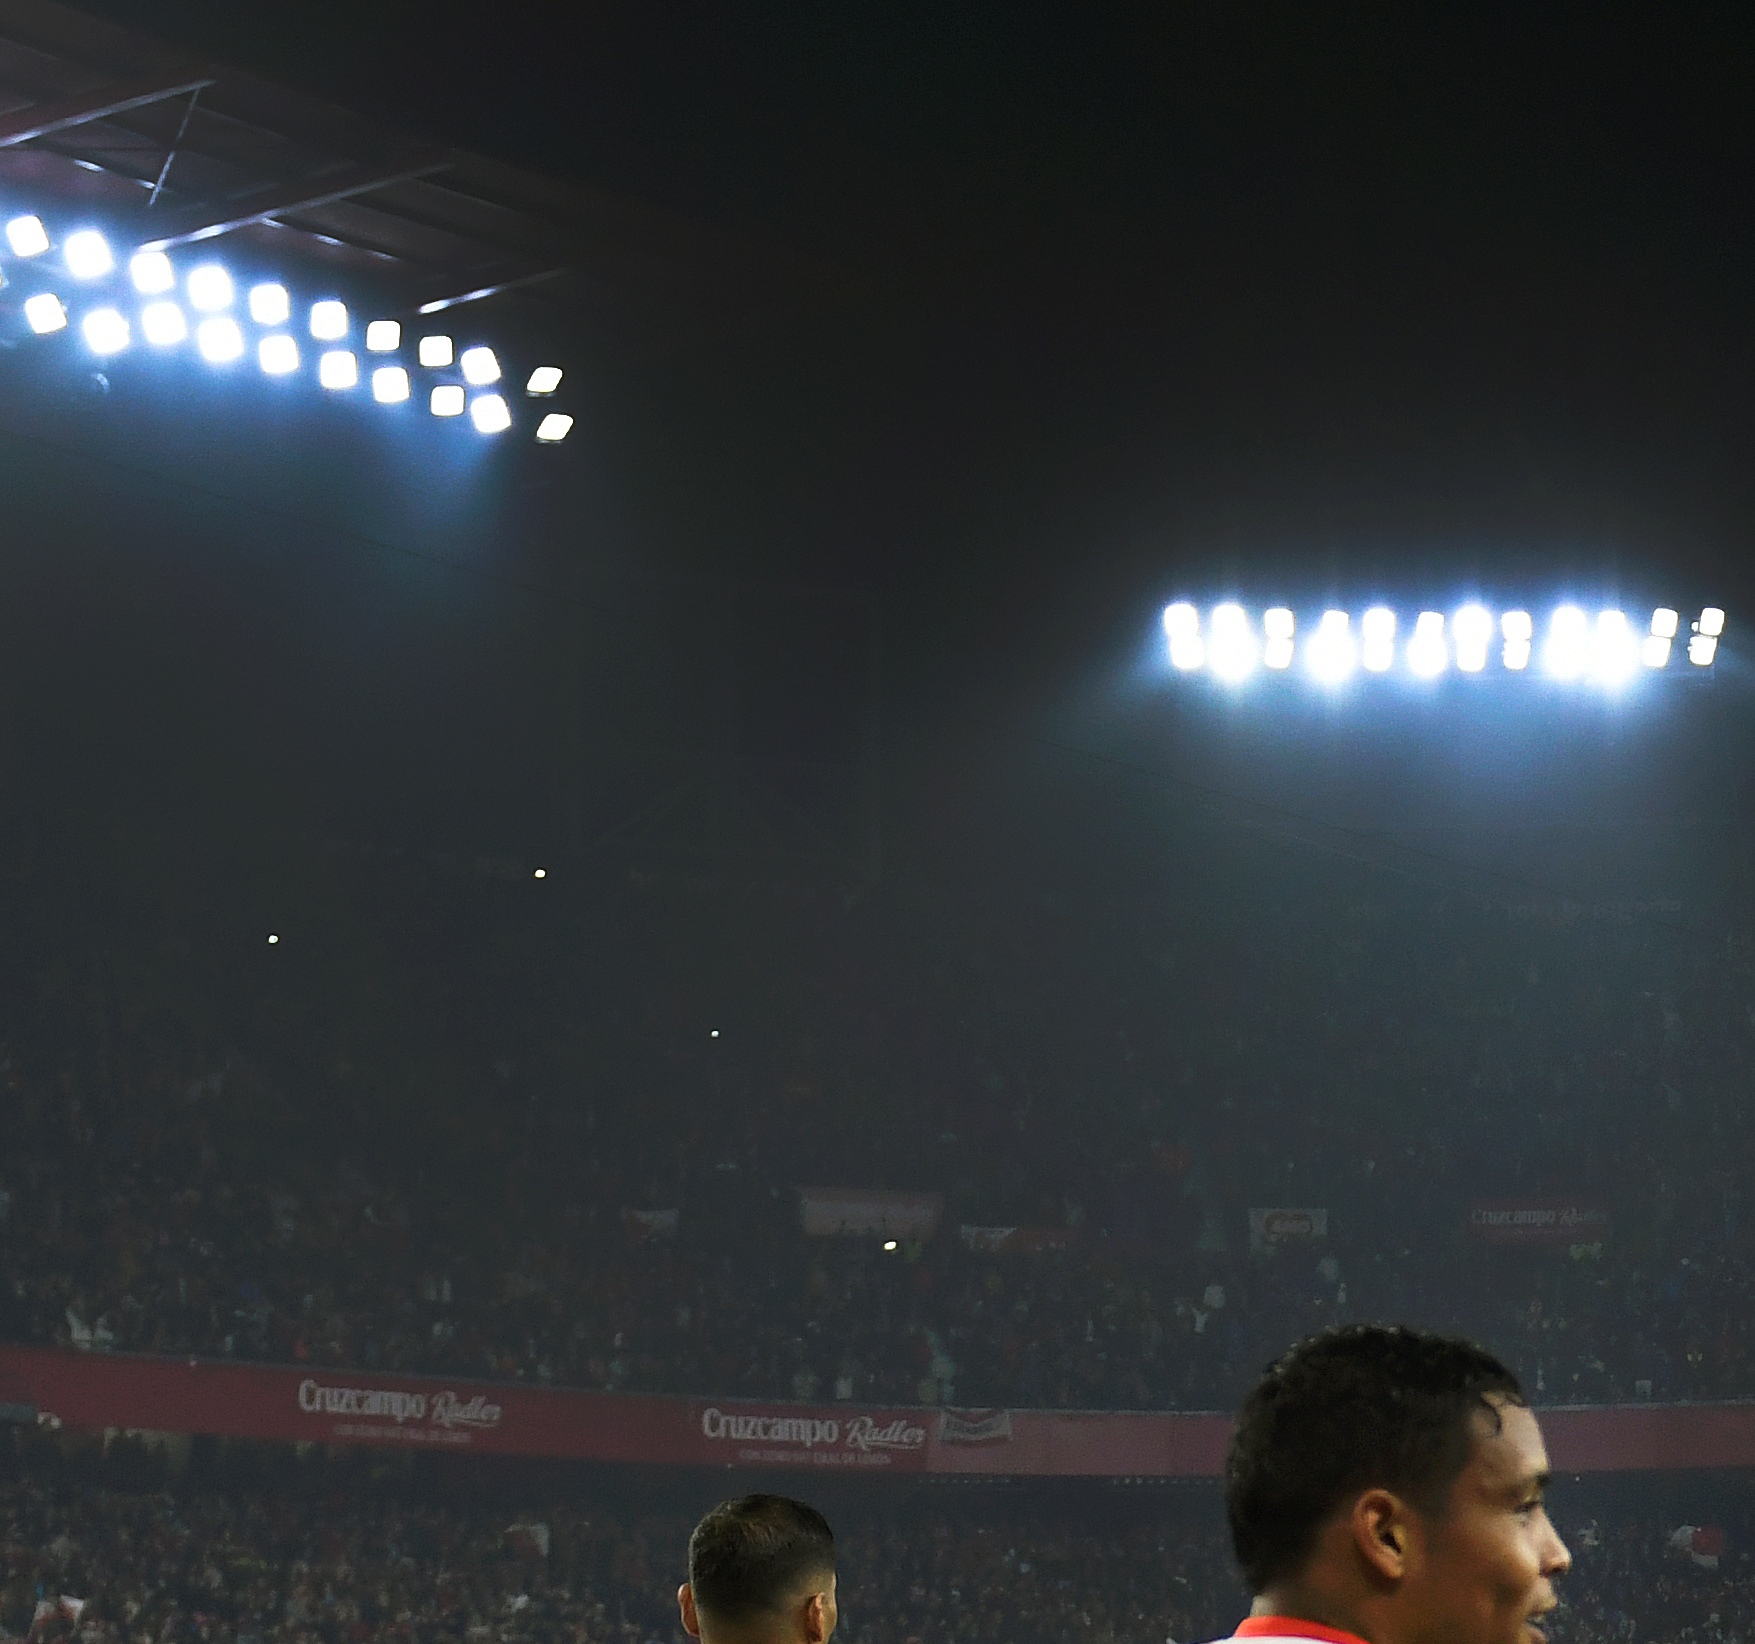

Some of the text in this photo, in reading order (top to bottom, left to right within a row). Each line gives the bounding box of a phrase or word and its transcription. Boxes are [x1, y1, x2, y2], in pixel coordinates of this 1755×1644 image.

[299, 1379, 503, 1428] Cruzcampo Radler
[702, 1407, 840, 1448] Cruzcampo
[844, 1416, 927, 1453] Radler
